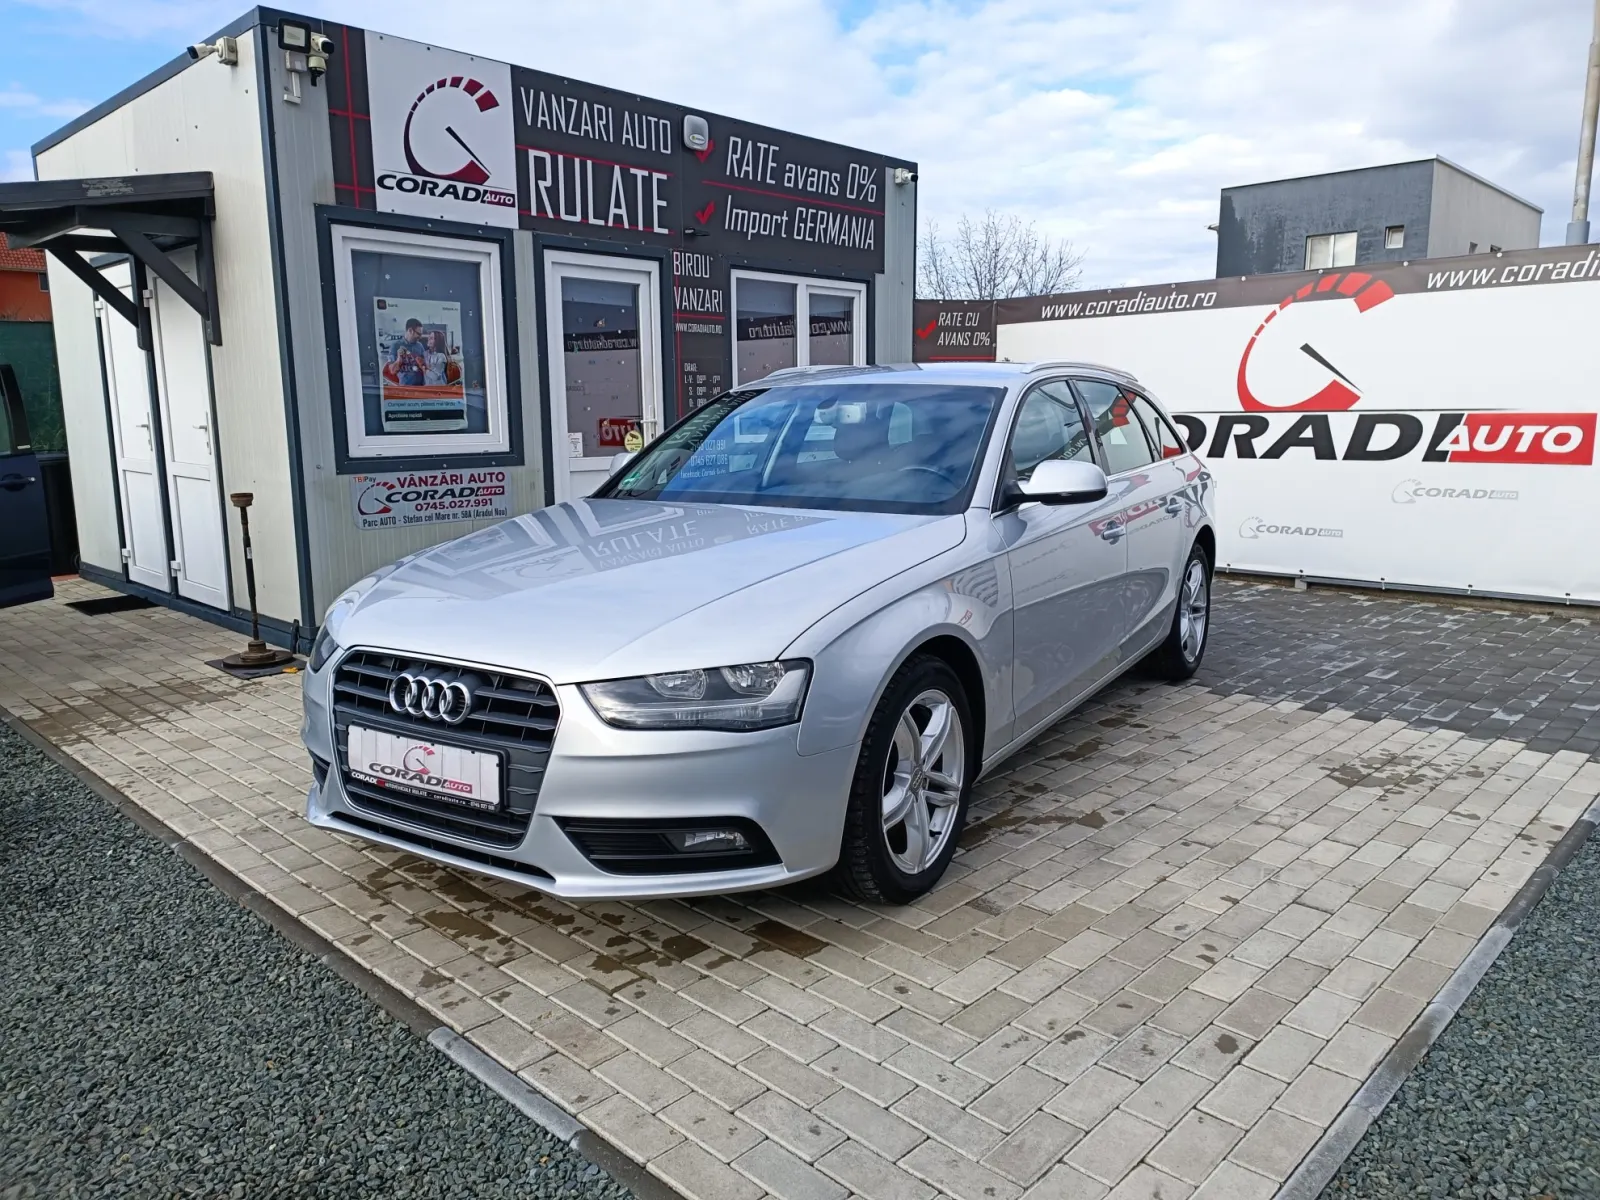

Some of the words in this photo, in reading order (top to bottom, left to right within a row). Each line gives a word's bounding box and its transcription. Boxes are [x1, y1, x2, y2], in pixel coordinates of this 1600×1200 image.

[520, 86, 614, 143] VANZARI
[622, 110, 672, 154] AUTO
[725, 136, 779, 185] RATE
[784, 163, 840, 196] avans
[846, 163, 877, 203] 0%
[484, 193, 513, 205] AUTO
[528, 149, 669, 234] RULATE
[725, 195, 788, 241] Import
[794, 206, 875, 250] GERMANIA
[673, 251, 709, 278] BIROU
[1427, 250, 1600, 289] www.coradi
[673, 286, 723, 313] VANZARI
[1041, 291, 1217, 319] www.coradiauto.ro
[938, 312, 962, 327] RATE
[965, 312, 980, 327] CU
[937, 332, 970, 347] AVANS
[973, 332, 990, 347] 0%
[1436, 425, 1584, 454] AUTO
[396, 471, 464, 488] VÂNZĂRI
[467, 471, 505, 484] AUTO
[478, 487, 503, 496] AUTO
[1490, 490, 1517, 499] AUTO
[415, 498, 493, 512] 0745.027.991
[362, 519, 378, 528] Parc
[380, 516, 396, 526] AUTO
[424, 513, 434, 522] cel
[435, 511, 450, 521] Mare
[1319, 529, 1342, 537] AUTO
[443, 780, 470, 792] AUTO
